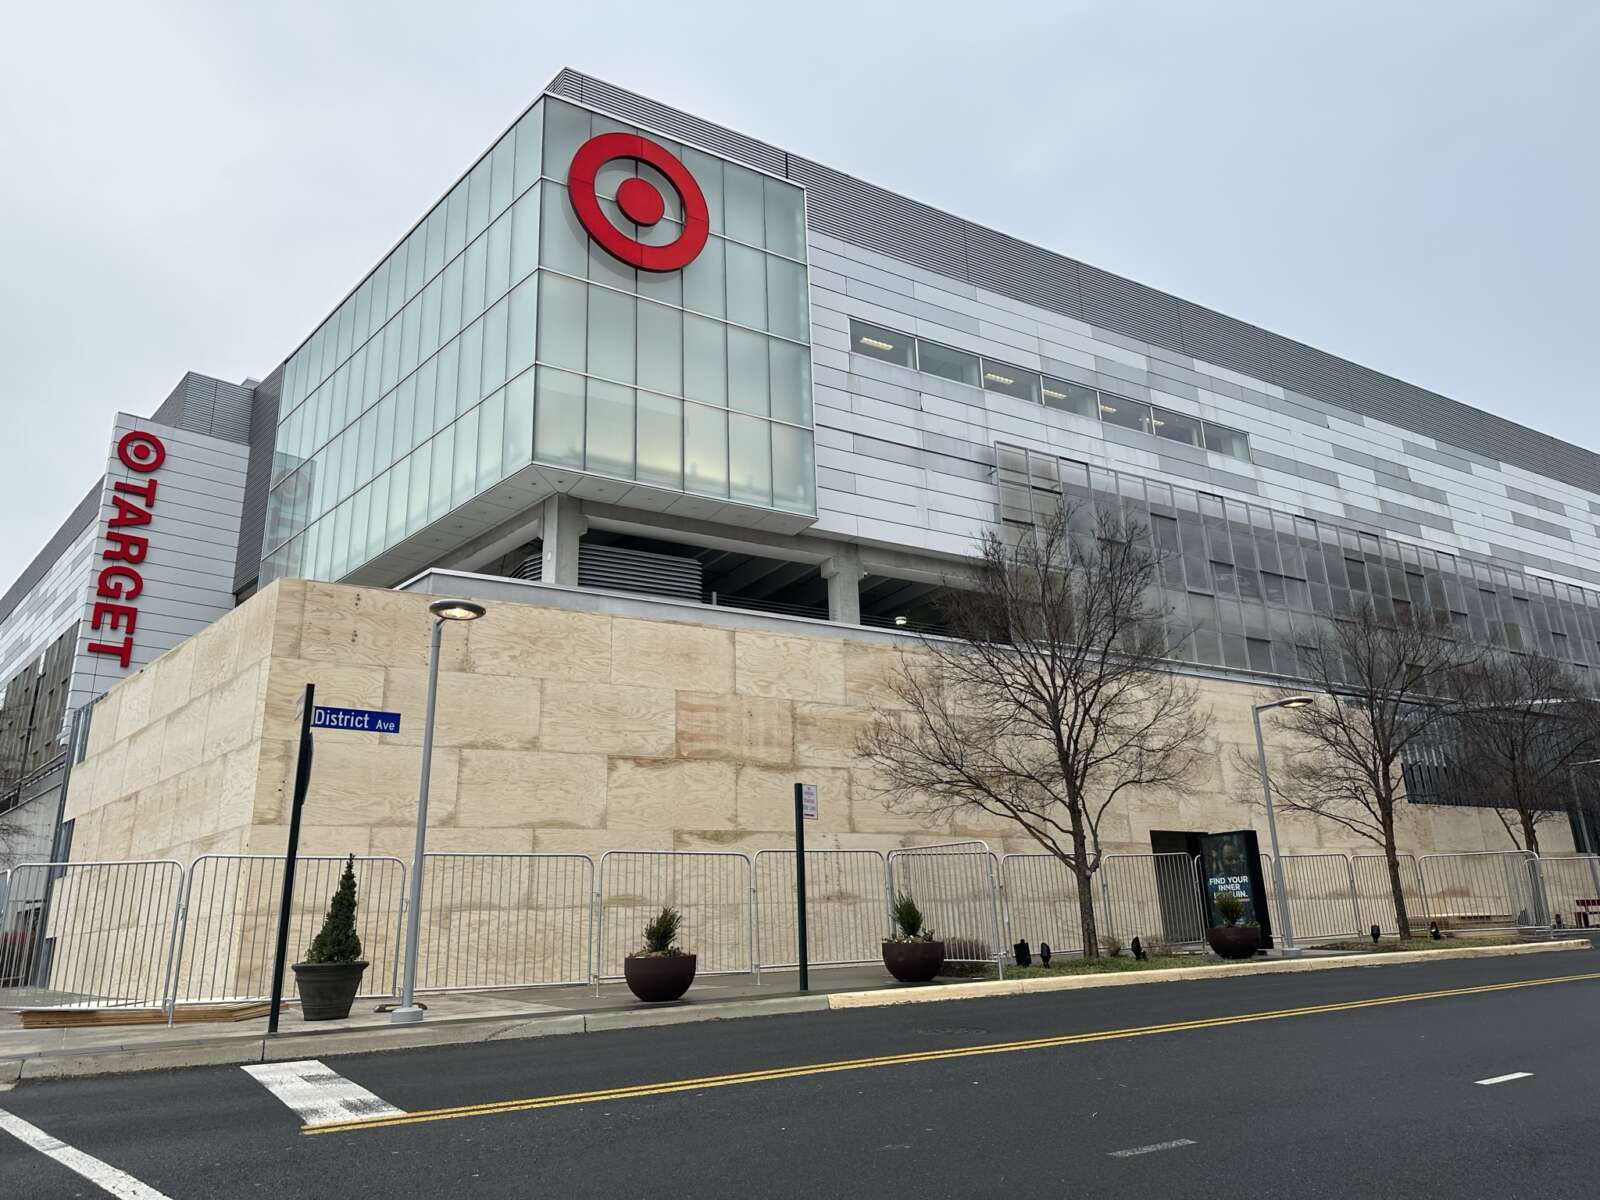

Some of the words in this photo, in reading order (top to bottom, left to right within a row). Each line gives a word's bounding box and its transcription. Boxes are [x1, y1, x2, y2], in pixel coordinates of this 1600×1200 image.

[87, 479, 157, 668] TARGET
[315, 709, 369, 728] District
[376, 719, 395, 731] Ave
[1209, 877, 1225, 885] FIND
[1227, 875, 1248, 884] YOUR
[1218, 883, 1241, 891] INNER
